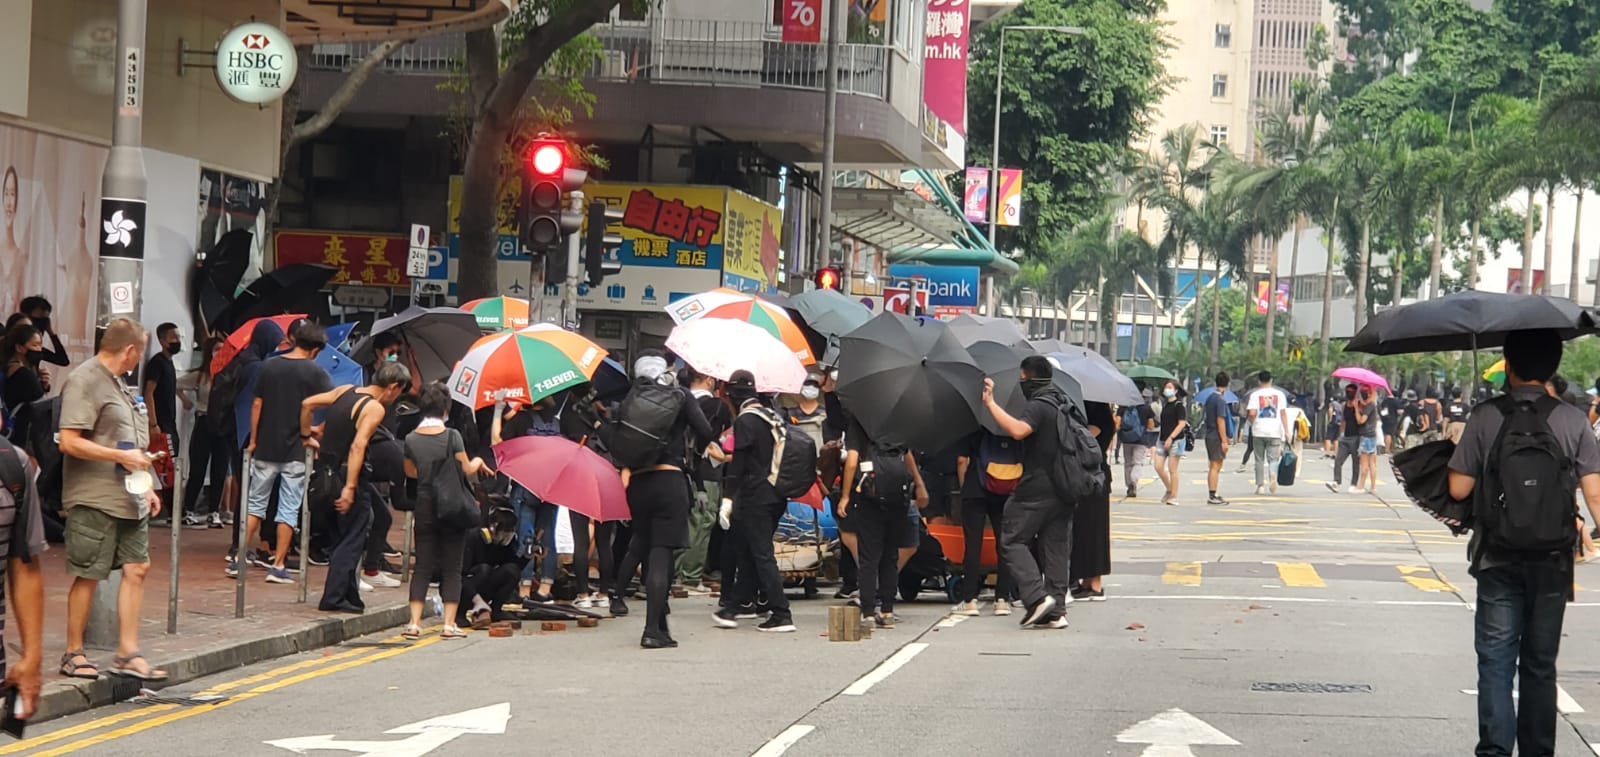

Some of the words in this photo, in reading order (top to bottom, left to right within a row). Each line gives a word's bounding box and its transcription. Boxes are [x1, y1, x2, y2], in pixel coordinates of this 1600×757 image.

[790, 1, 815, 26] 70
[868, 25, 880, 38] 70
[228, 51, 283, 71] HSBC
[126, 52, 137, 106] 43593
[623, 188, 721, 248] 自由行
[1003, 203, 1016, 217] 70
[322, 234, 392, 267] 豪星
[633, 238, 669, 257] 機票
[676, 250, 707, 266] 酒店
